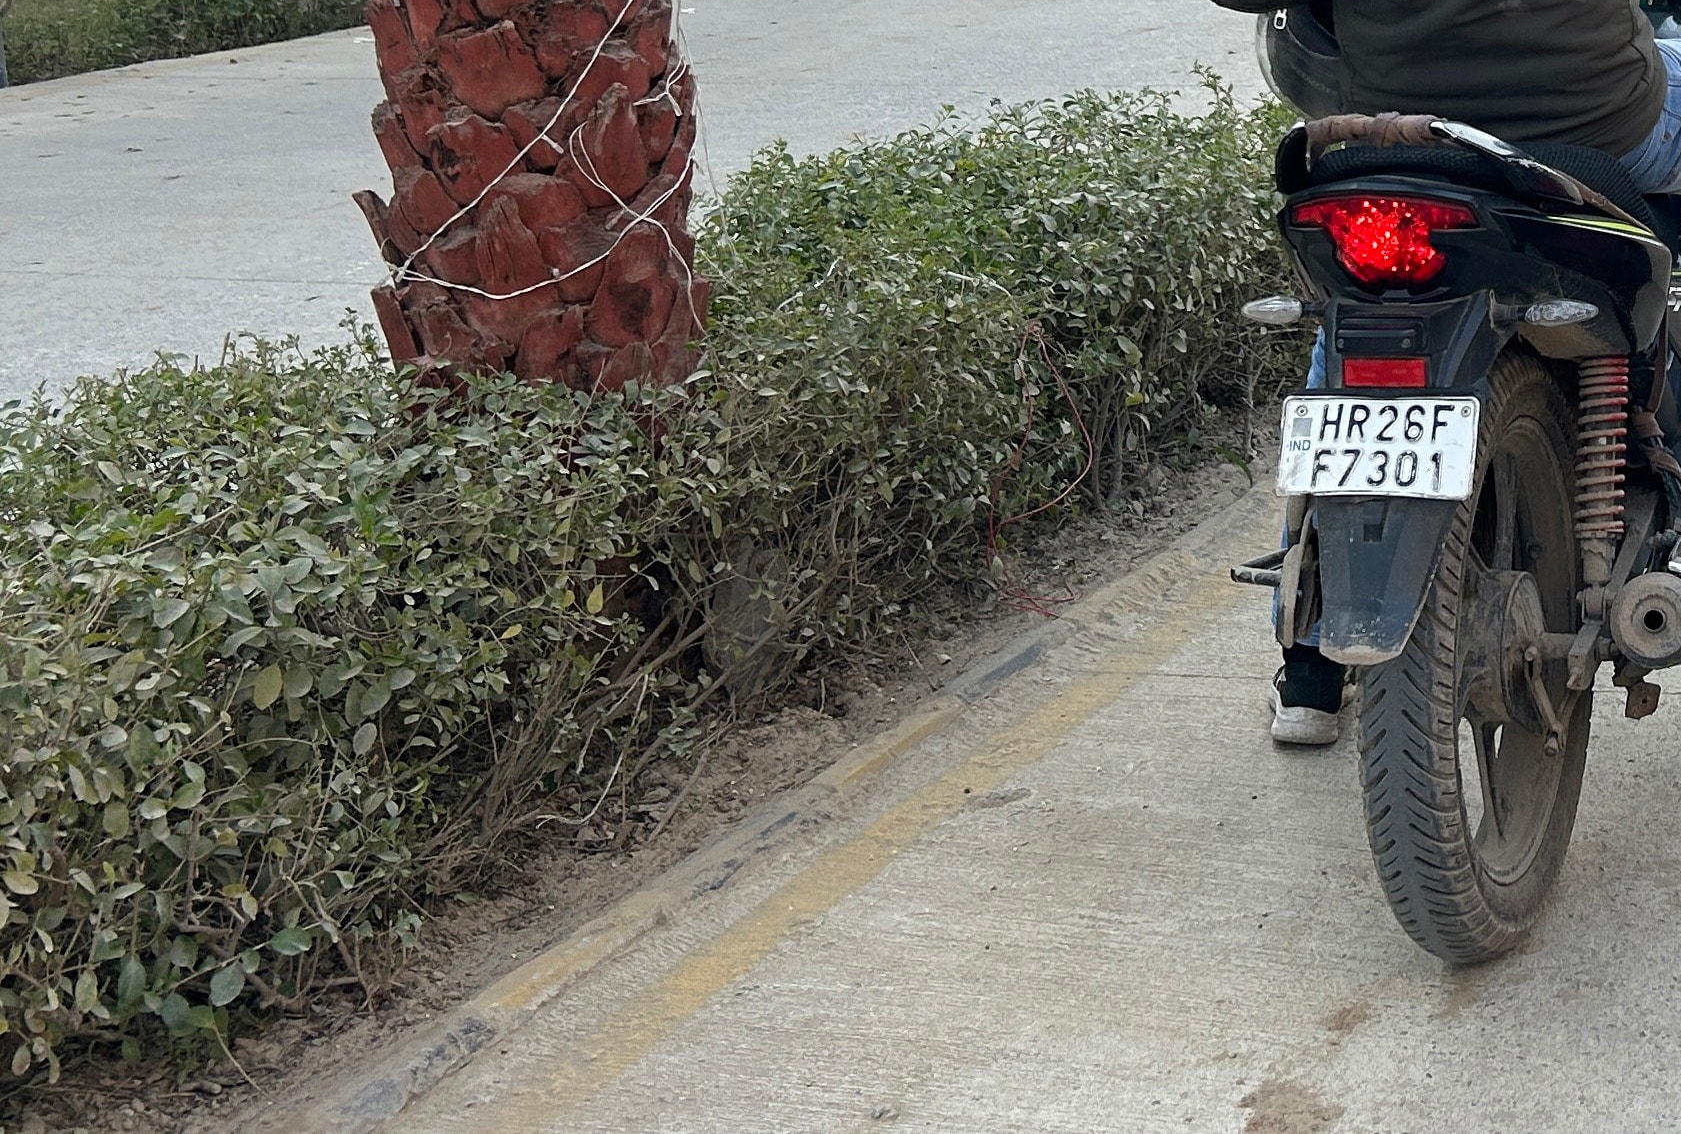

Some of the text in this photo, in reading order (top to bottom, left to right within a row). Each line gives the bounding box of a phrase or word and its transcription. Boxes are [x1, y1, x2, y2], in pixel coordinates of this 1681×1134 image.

[1318, 403, 1455, 445] HR26F
[1289, 439, 1311, 452] IND
[1310, 448, 1444, 492] F7301
